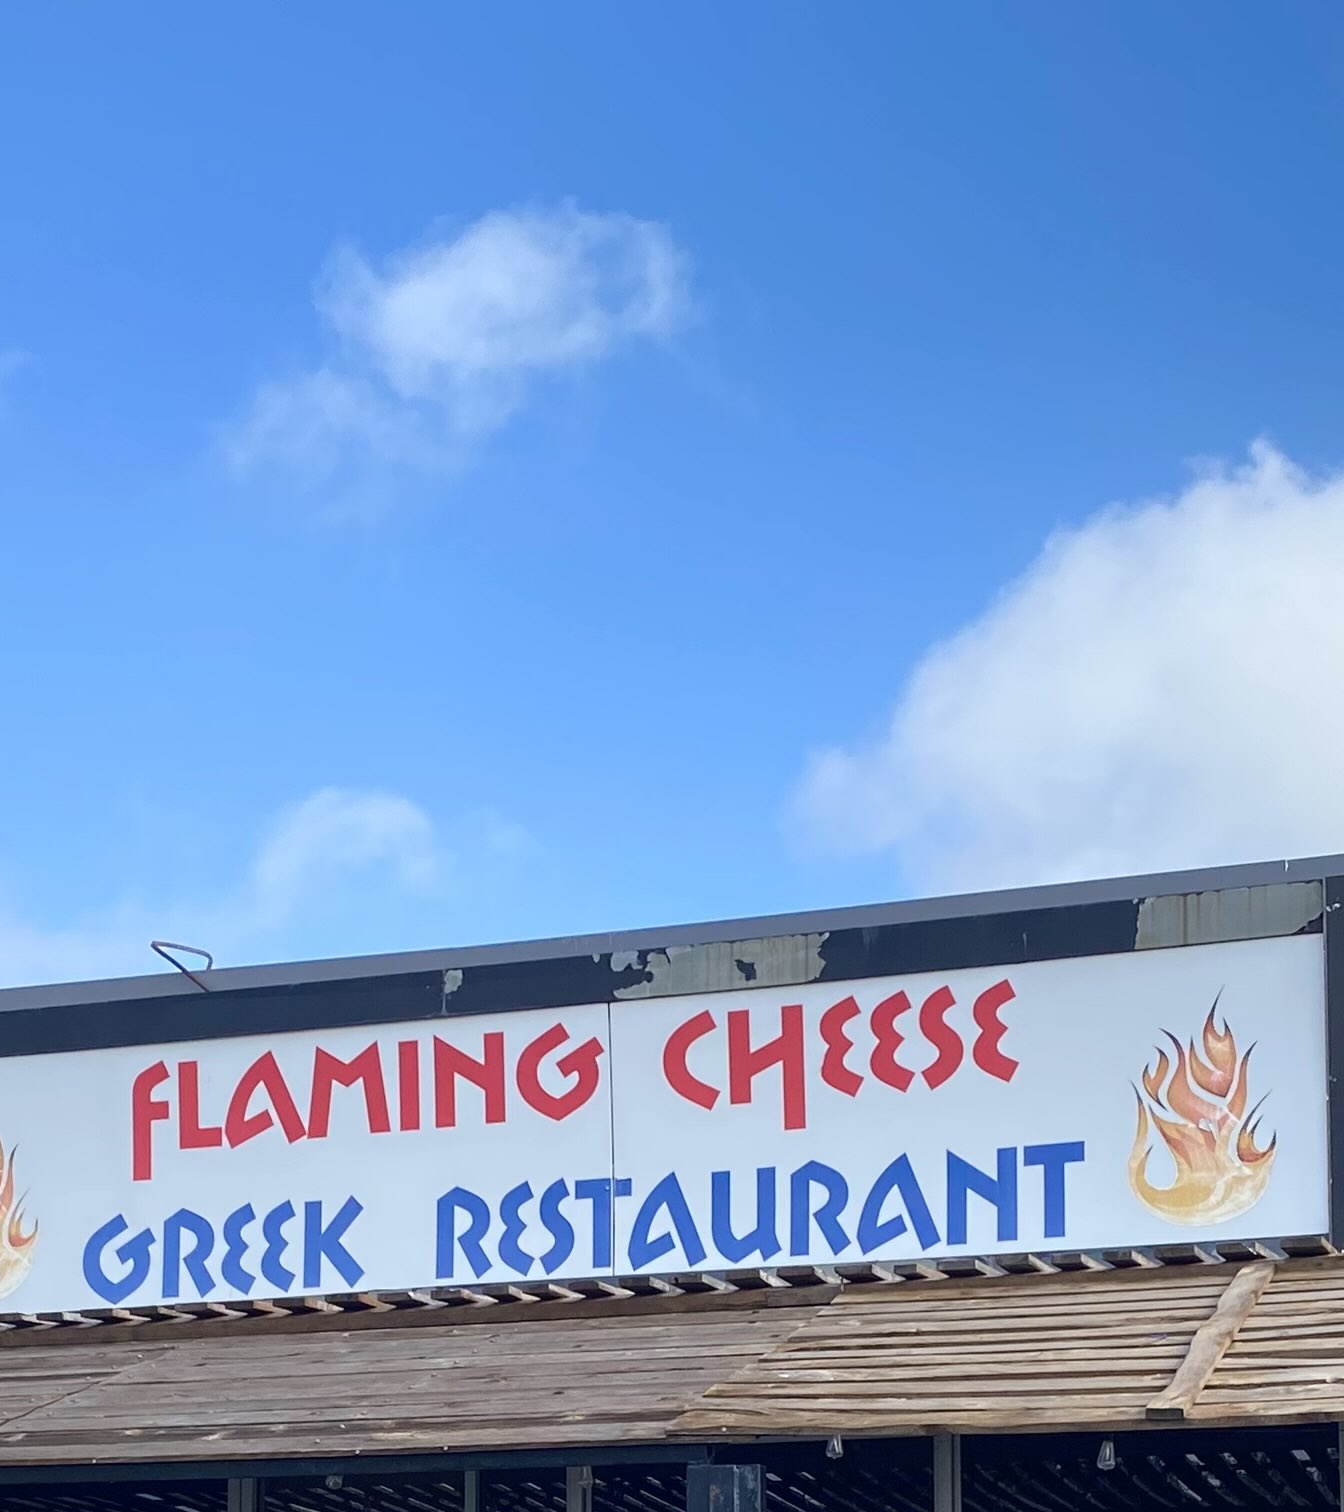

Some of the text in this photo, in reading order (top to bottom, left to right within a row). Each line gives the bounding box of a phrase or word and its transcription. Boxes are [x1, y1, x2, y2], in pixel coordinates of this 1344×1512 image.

[133, 979, 1018, 1180] FLAMING CHEESE
[81, 1139, 1086, 1305] GREEK RESTAURANT
